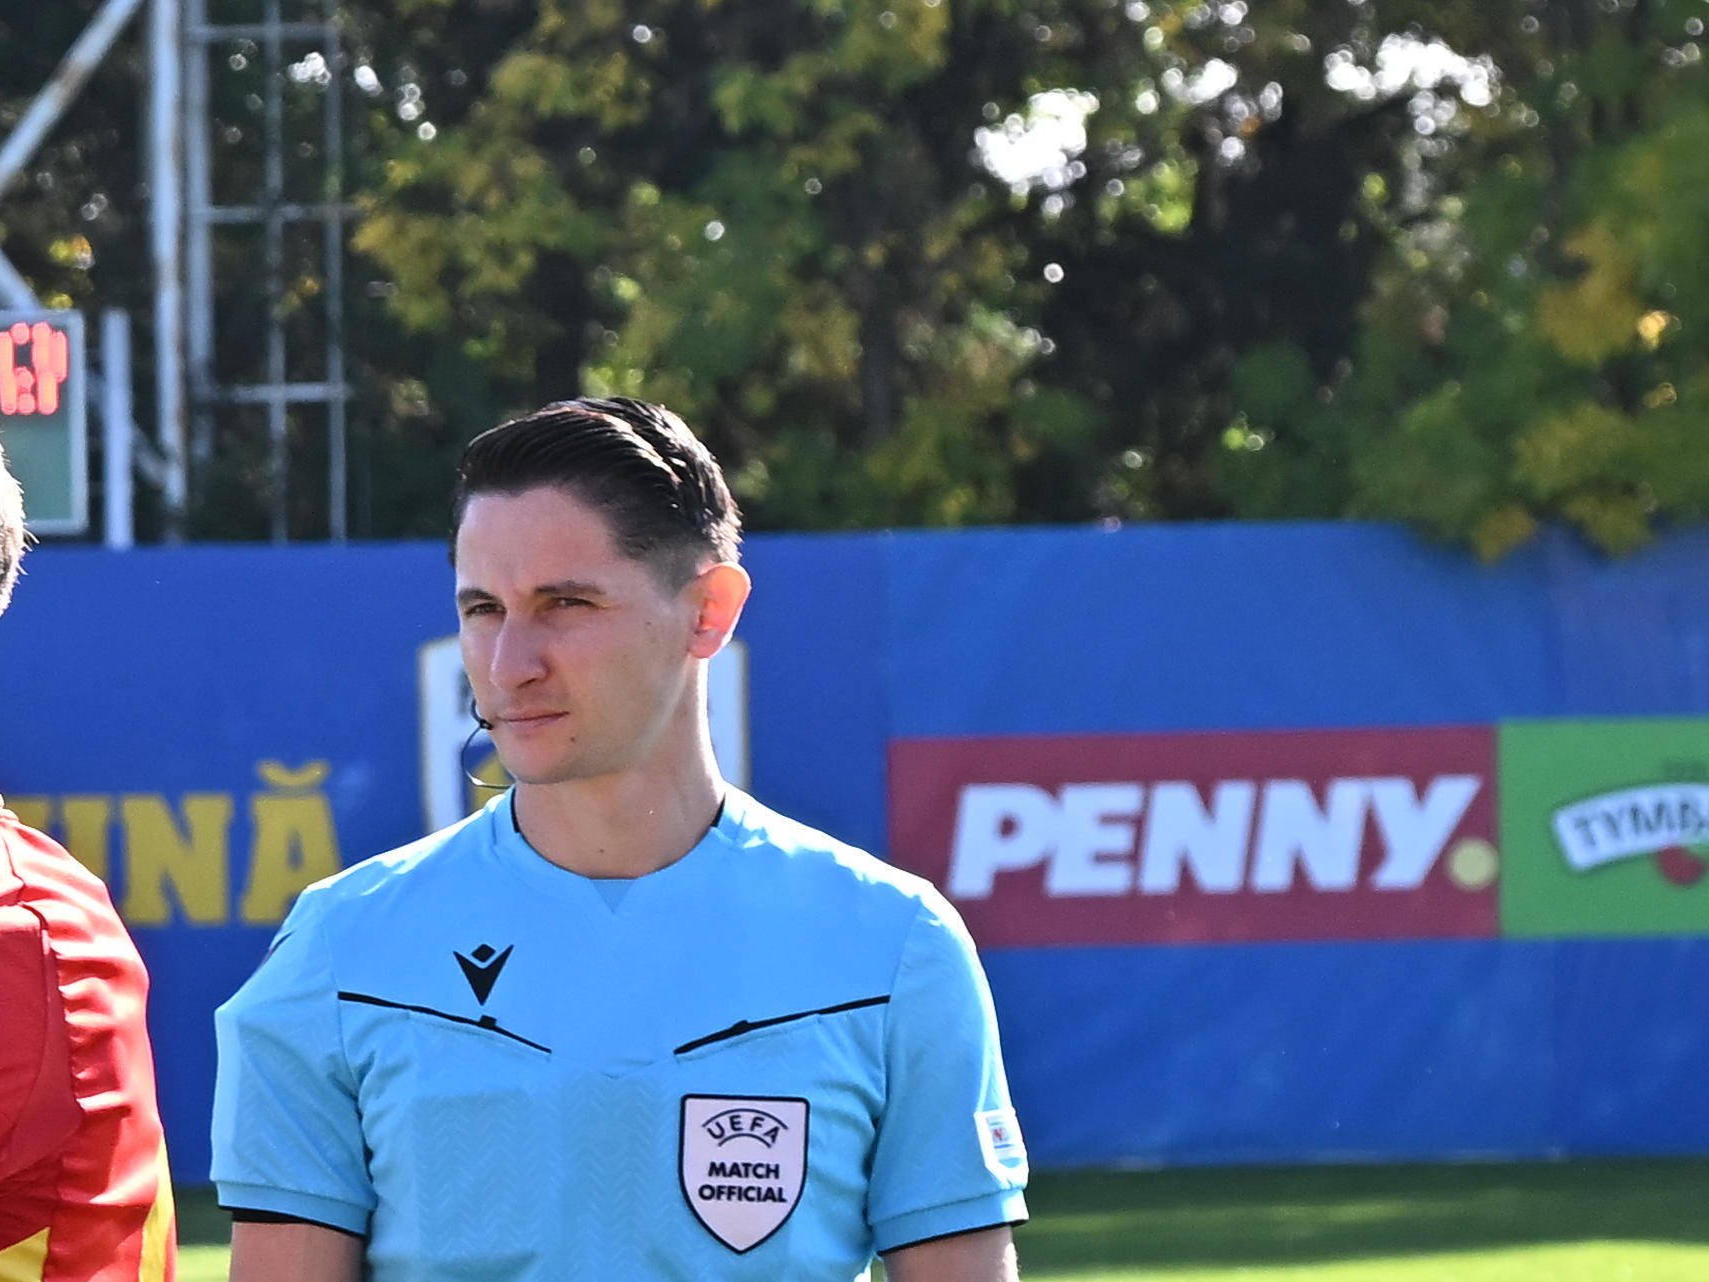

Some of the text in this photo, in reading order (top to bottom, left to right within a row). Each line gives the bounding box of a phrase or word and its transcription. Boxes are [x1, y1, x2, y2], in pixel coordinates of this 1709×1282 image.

[707, 1115, 780, 1142] UEFA
[708, 1161, 780, 1179] MATCH
[698, 1184, 787, 1203] OFFICIAL
